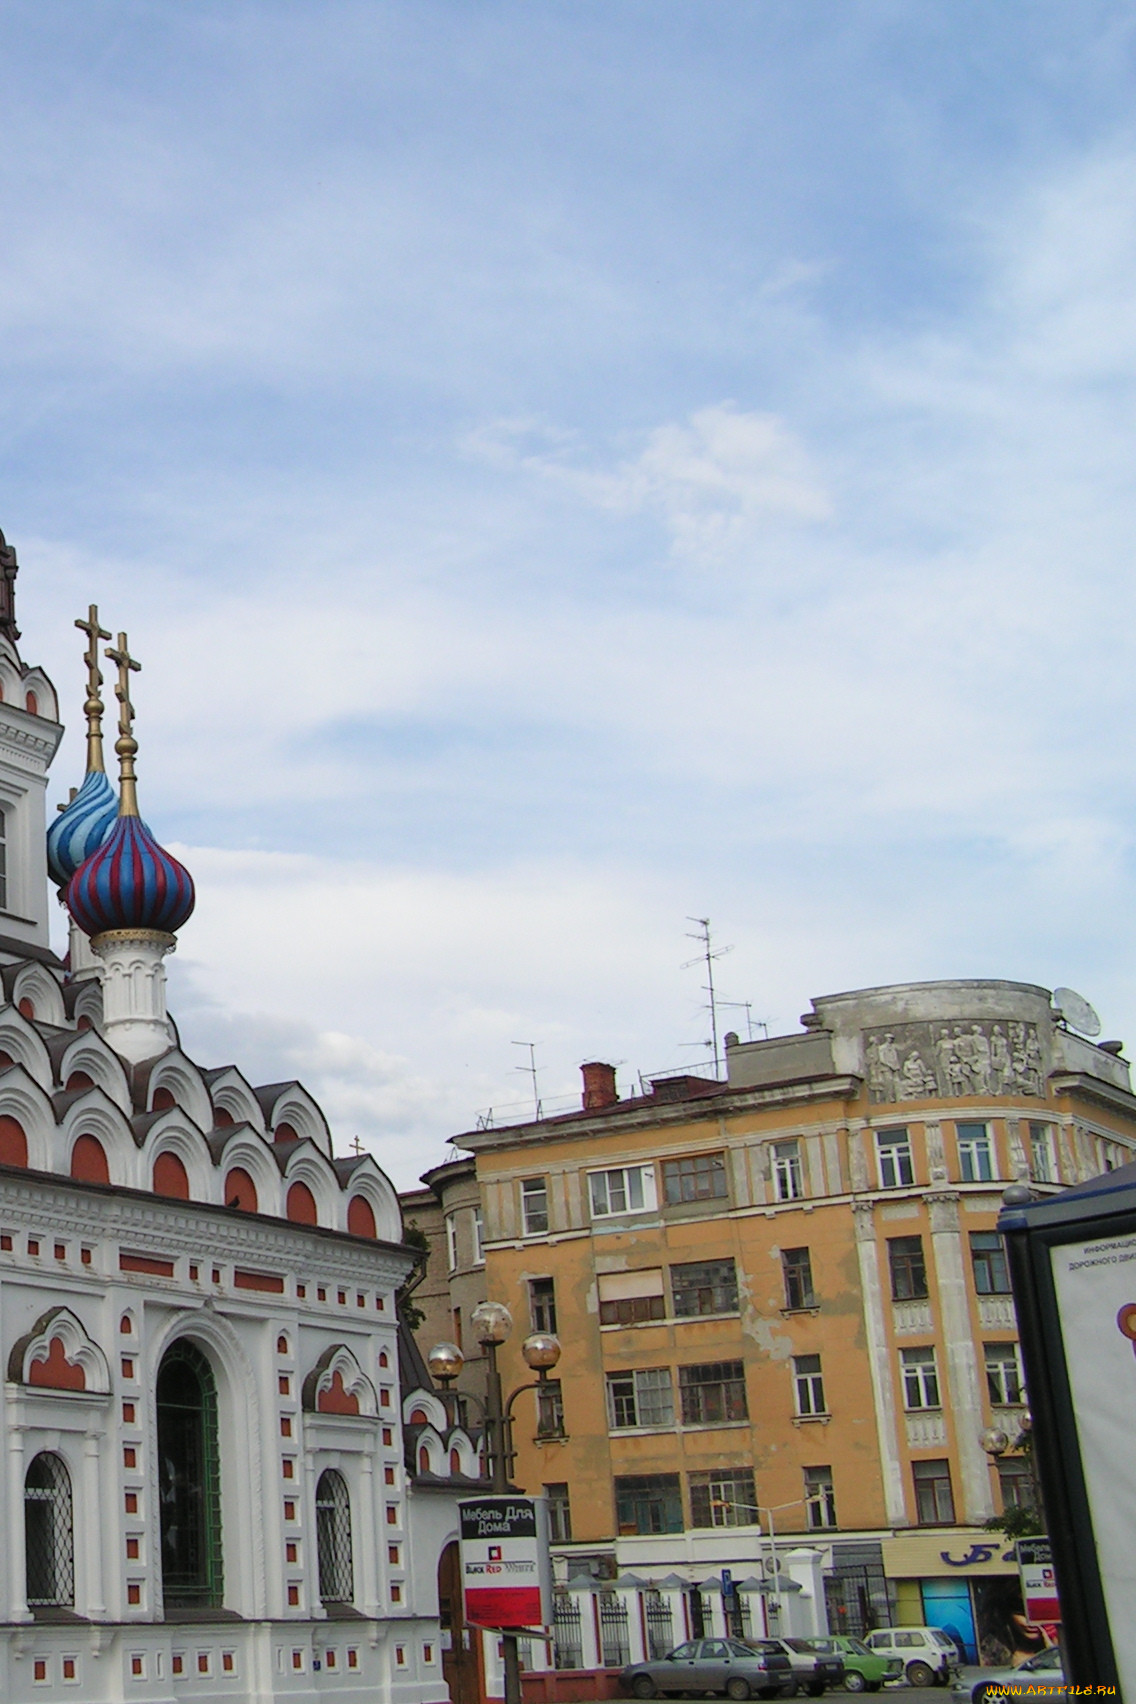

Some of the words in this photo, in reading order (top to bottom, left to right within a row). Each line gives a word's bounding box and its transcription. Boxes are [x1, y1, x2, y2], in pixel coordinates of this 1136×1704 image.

[462, 1508, 503, 1521] Мебель
[505, 1506, 534, 1521] Для
[478, 1520, 511, 1535] Дома
